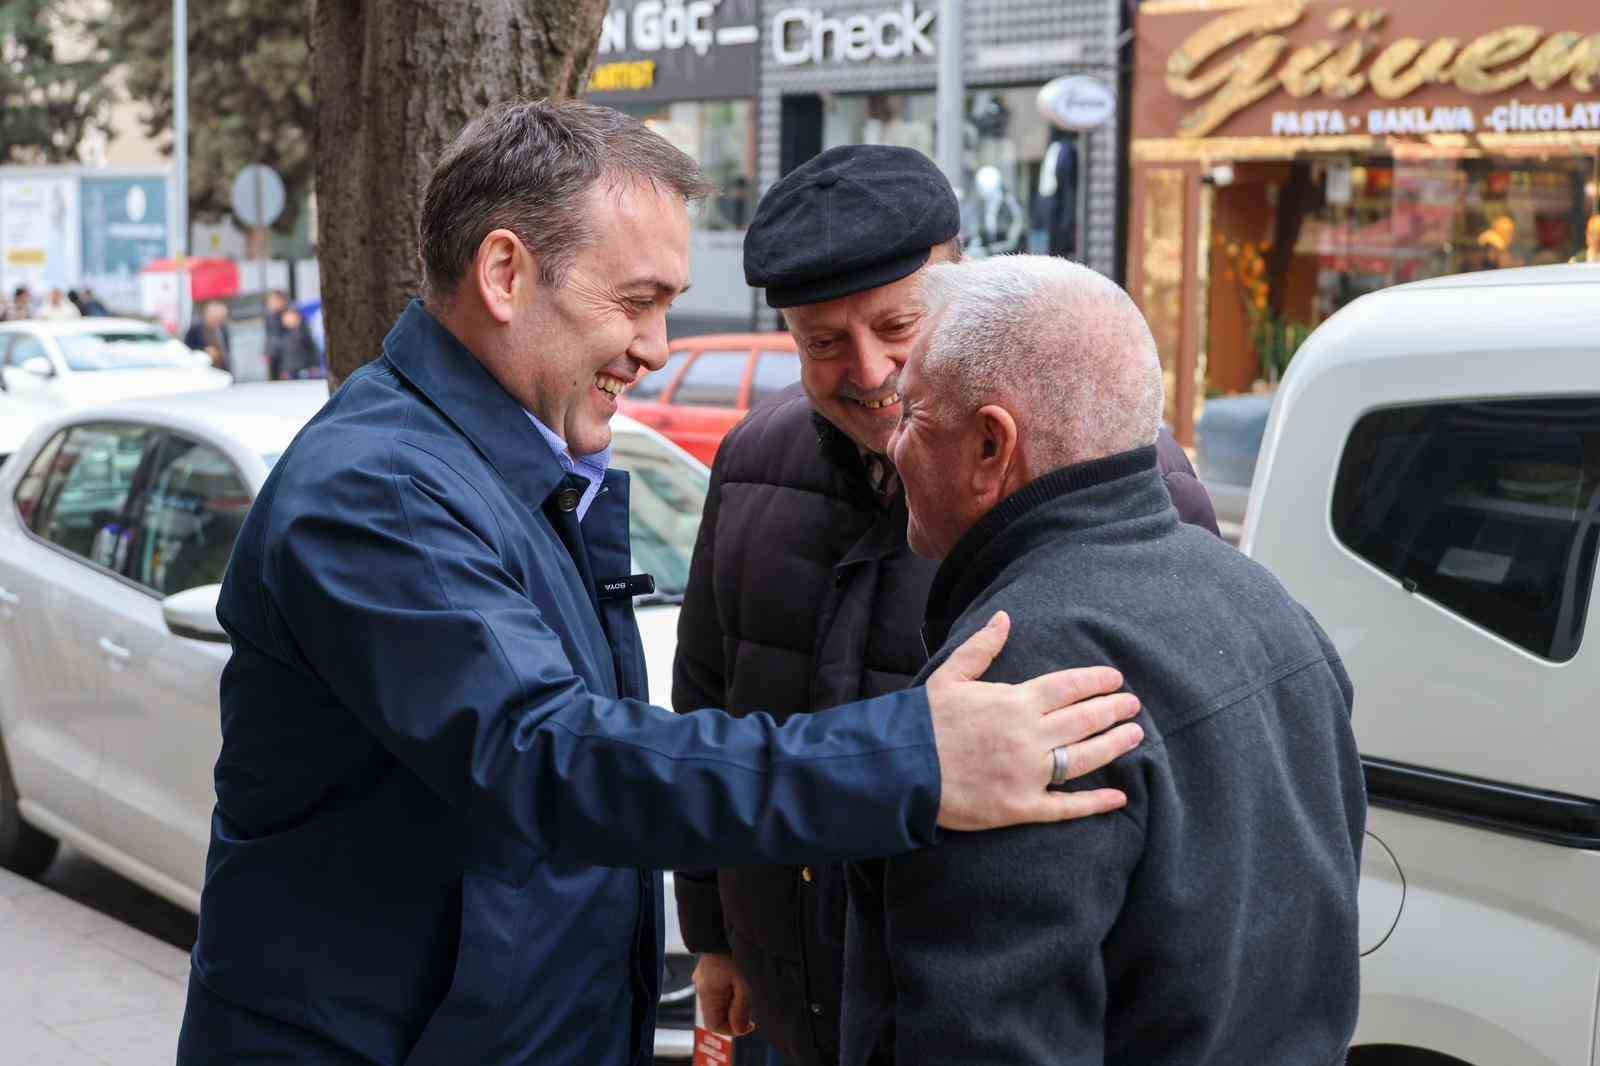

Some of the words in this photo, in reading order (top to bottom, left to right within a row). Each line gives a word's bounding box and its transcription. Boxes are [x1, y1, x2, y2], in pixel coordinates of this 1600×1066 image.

[773, 0, 937, 64] Check
[1272, 110, 1345, 135] PASTA
[1367, 105, 1475, 133] BAKLAVA
[604, 582, 626, 591] BOYA
